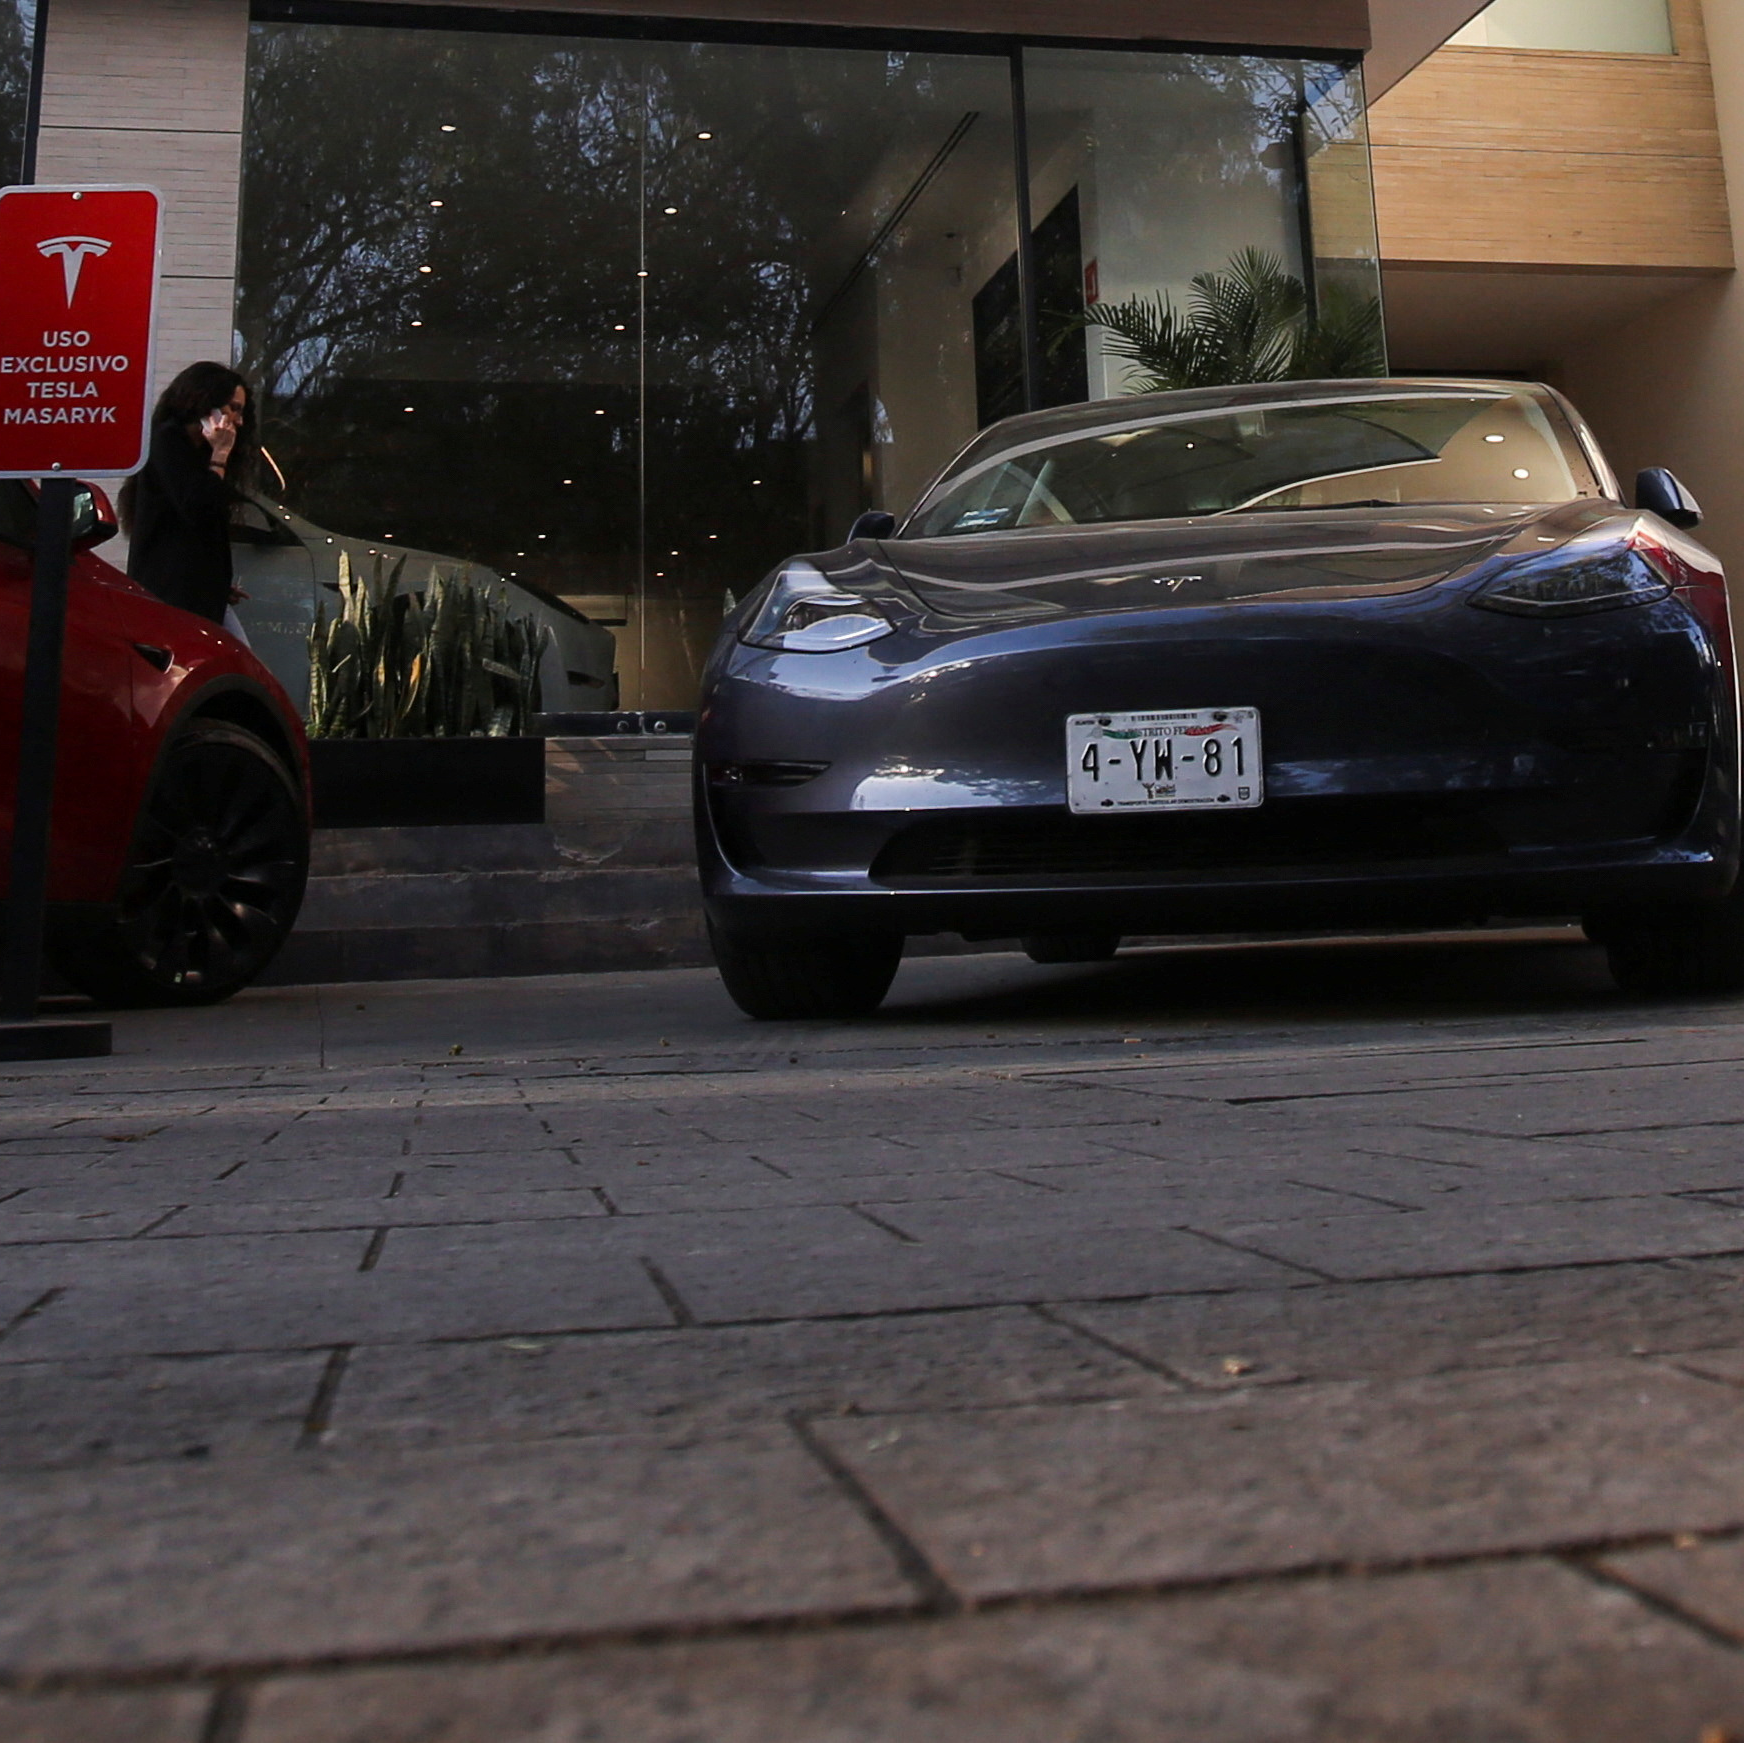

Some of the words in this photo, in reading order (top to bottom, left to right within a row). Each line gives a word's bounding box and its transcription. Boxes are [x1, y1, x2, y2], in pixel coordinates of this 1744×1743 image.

[42, 330, 91, 348] USO
[0, 355, 129, 373] EXCLUSIVO
[27, 381, 99, 398] TESLA
[3, 406, 117, 424] MASARYK
[1081, 736, 1244, 782] 4-YW-81
